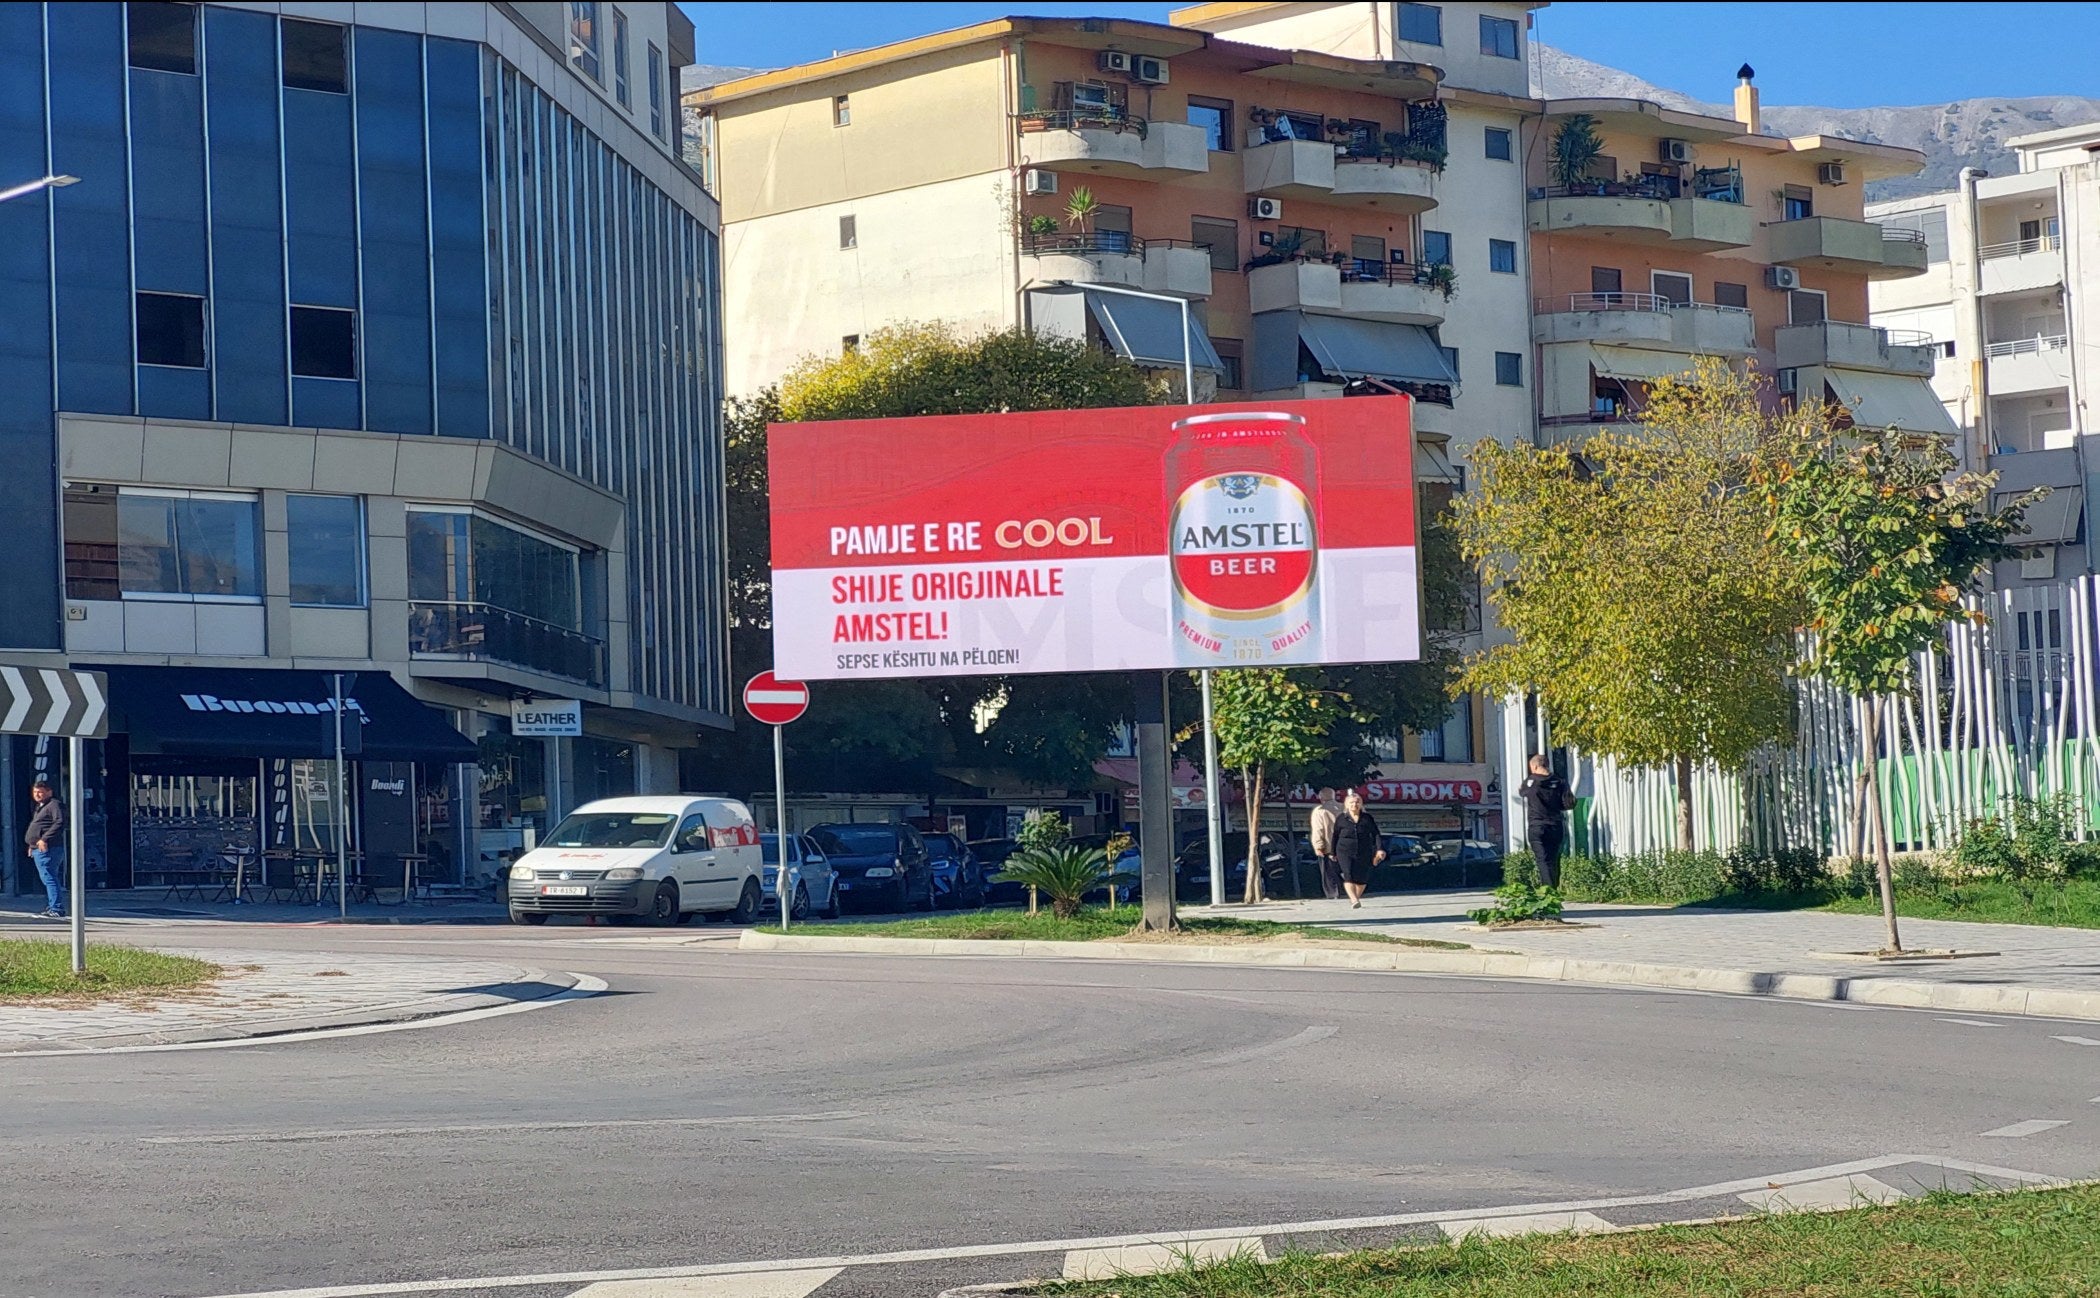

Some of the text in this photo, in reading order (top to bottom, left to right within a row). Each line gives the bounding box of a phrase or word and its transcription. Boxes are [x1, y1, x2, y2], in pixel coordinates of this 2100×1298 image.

[830, 517, 1114, 555] PAMJE E RE COOL
[1181, 522, 1304, 549] AMSTEL
[1210, 558, 1276, 576] BEER
[831, 568, 1064, 604] SHIJE ORIGJINALE
[833, 611, 948, 643] AMSTEL!
[1179, 620, 1313, 653] PREMIUM QUALITY
[837, 648, 1020, 670] SEPSE KËSHTU NA PËLQEN!
[516, 712, 577, 725] LEATHER
[1367, 782, 1474, 800] STROKA
